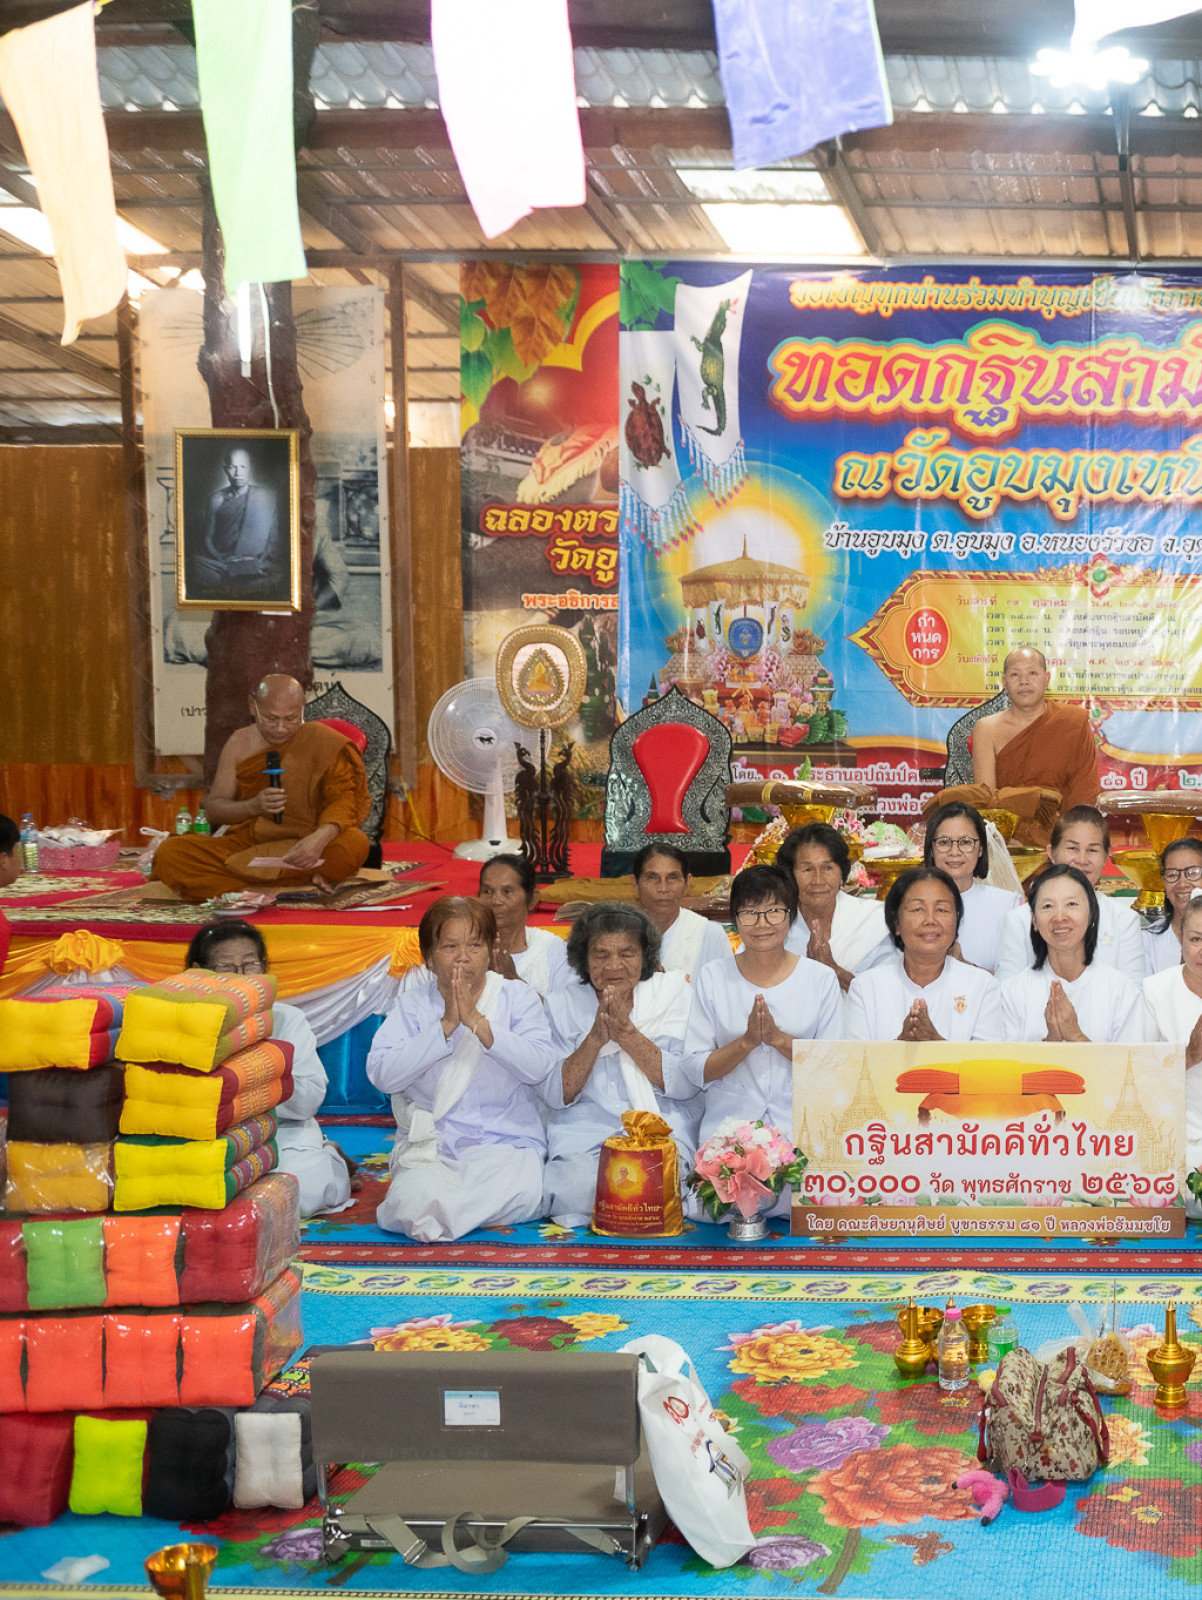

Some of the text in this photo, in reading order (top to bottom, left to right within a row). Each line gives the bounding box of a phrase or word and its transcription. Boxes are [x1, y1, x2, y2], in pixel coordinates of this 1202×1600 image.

[838, 455, 888, 495] ณ
[824, 524, 926, 557] บ้านอูบมุง
[931, 531, 1014, 559] ต.อูบมุง
[1022, 527, 1154, 554] อ.หนองวัวซอ
[911, 630, 942, 644] หนด
[912, 647, 941, 661] การ
[844, 1113, 1135, 1166] กฐินสามัคคีทั่วไทย
[804, 1172, 1176, 1201] ๓๐,๐๐๐ วัด พุทธศักราช ๒๕๖๘
[807, 1214, 1172, 1235] โดย คณะศิษยานุศิษย์ บูชาธรรม ๘๑ ปี หลวงพ่อธัมมชโย
